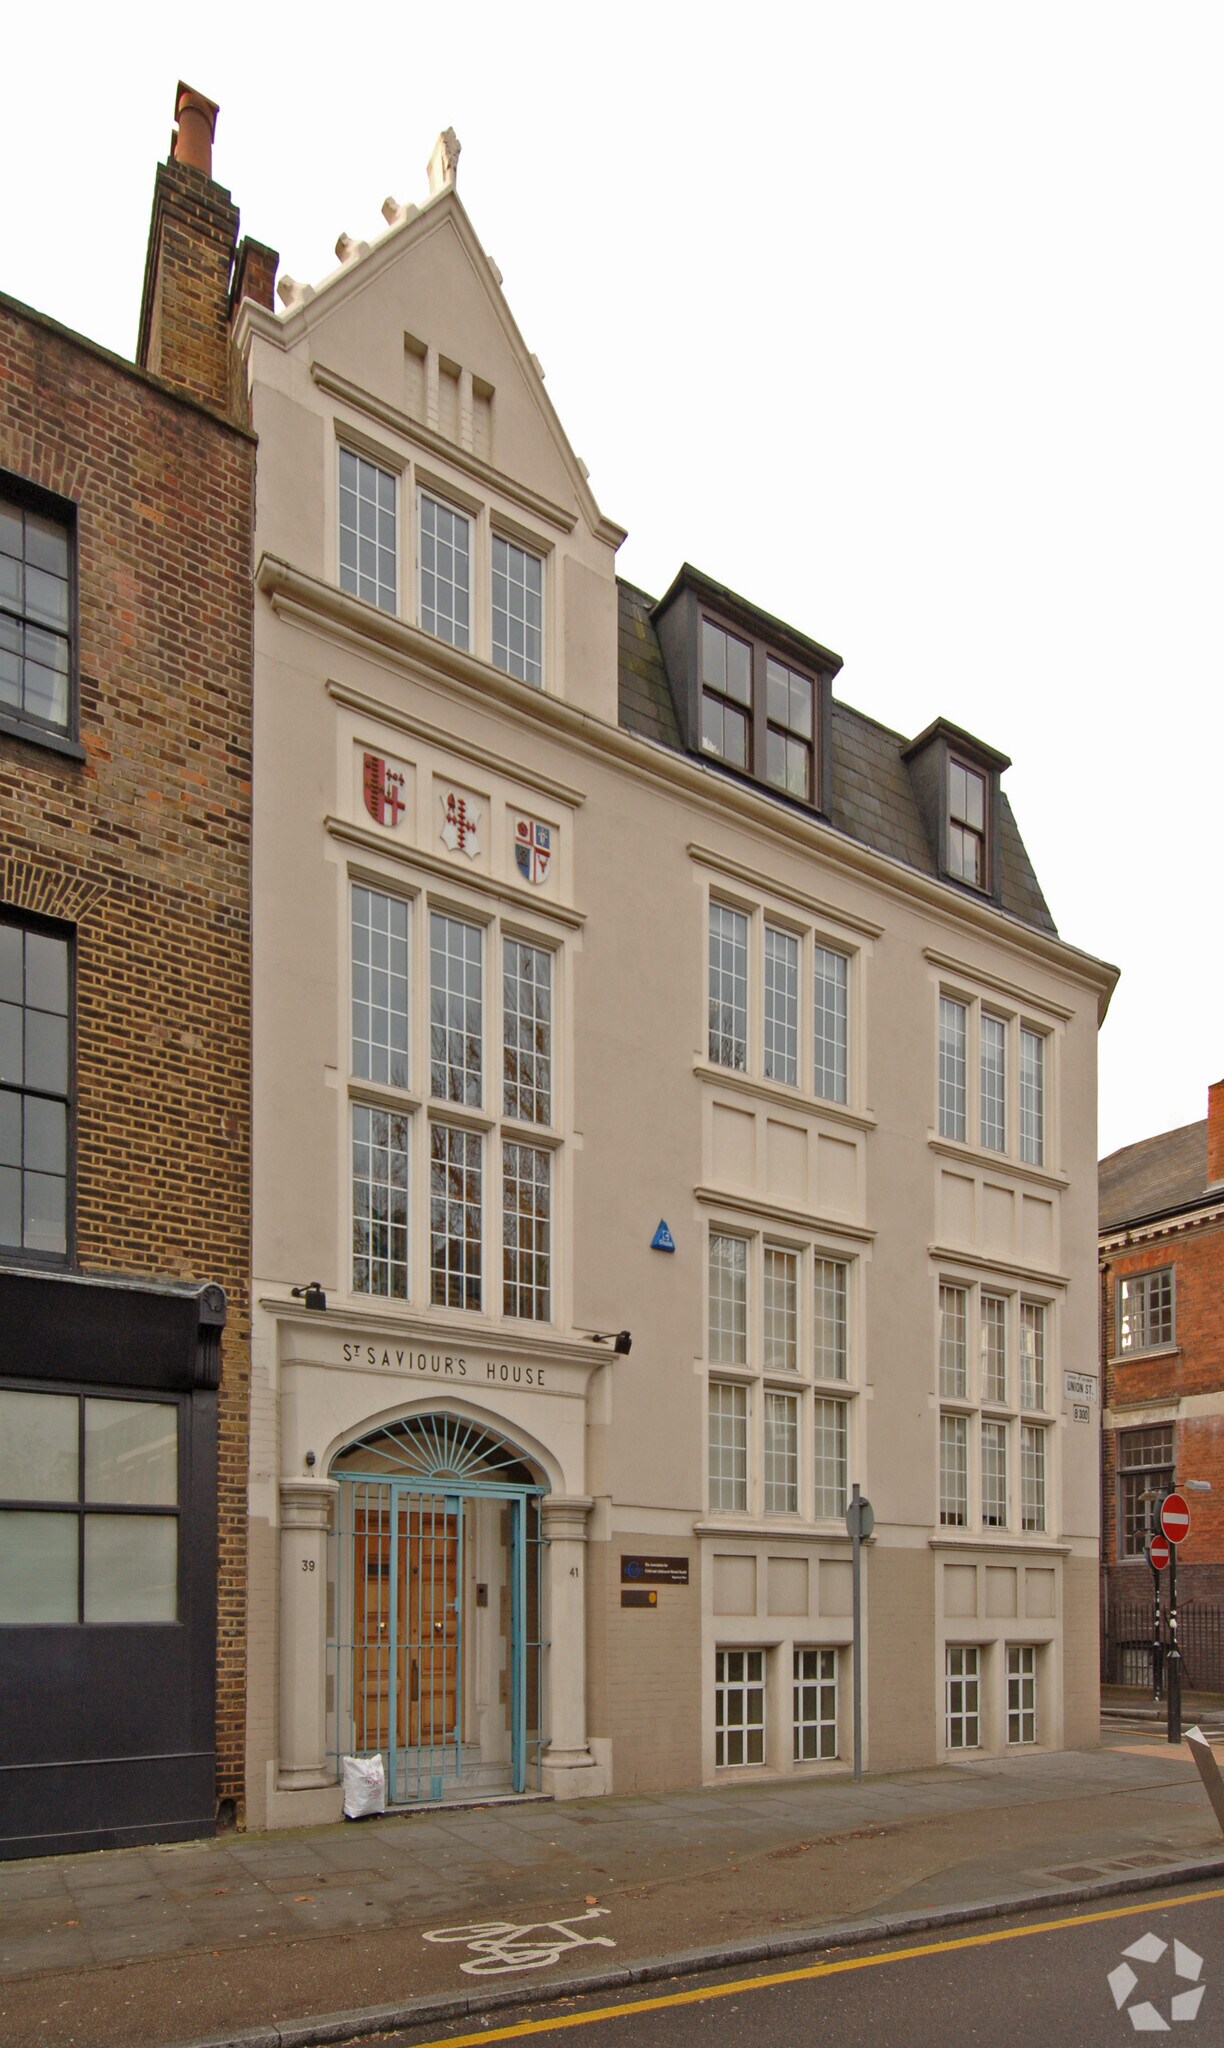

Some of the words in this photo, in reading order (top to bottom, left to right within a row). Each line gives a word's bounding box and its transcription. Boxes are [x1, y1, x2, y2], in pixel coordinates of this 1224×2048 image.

[486, 1362, 545, 1386] HOUSE
[1067, 1380, 1083, 1394] UNION
[302, 1559, 315, 1572] 39
[569, 1567, 579, 1578] 41
